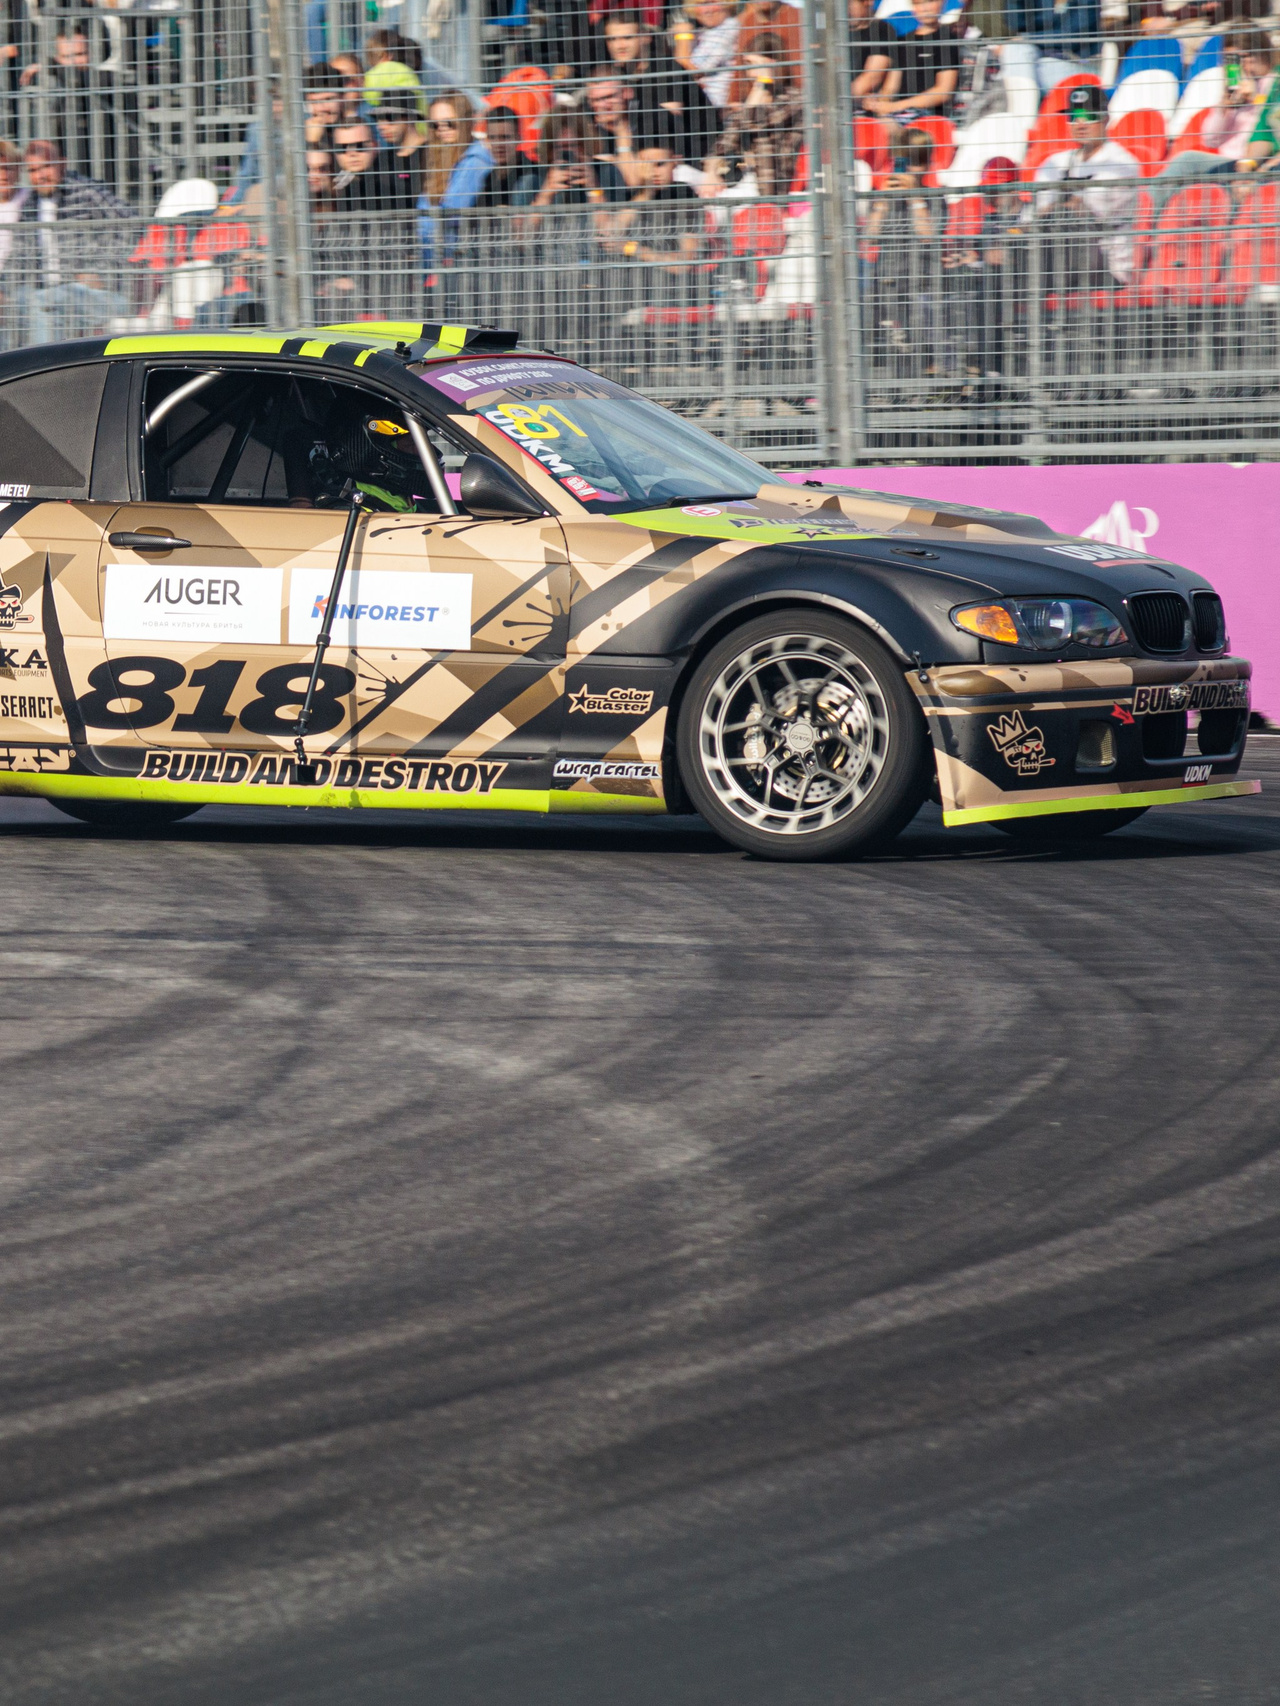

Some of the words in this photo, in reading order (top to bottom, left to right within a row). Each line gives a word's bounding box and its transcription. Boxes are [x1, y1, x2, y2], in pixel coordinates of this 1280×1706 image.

[144, 577, 243, 605] AUGER
[14, 670, 48, 678] EQUIPMENT
[77, 656, 356, 736] 818
[609, 689, 651, 701] Color
[585, 700, 650, 712] Blaster
[143, 752, 249, 783] BUILD
[333, 758, 506, 794] DESTROY
[1184, 764, 1213, 783] UDKM
